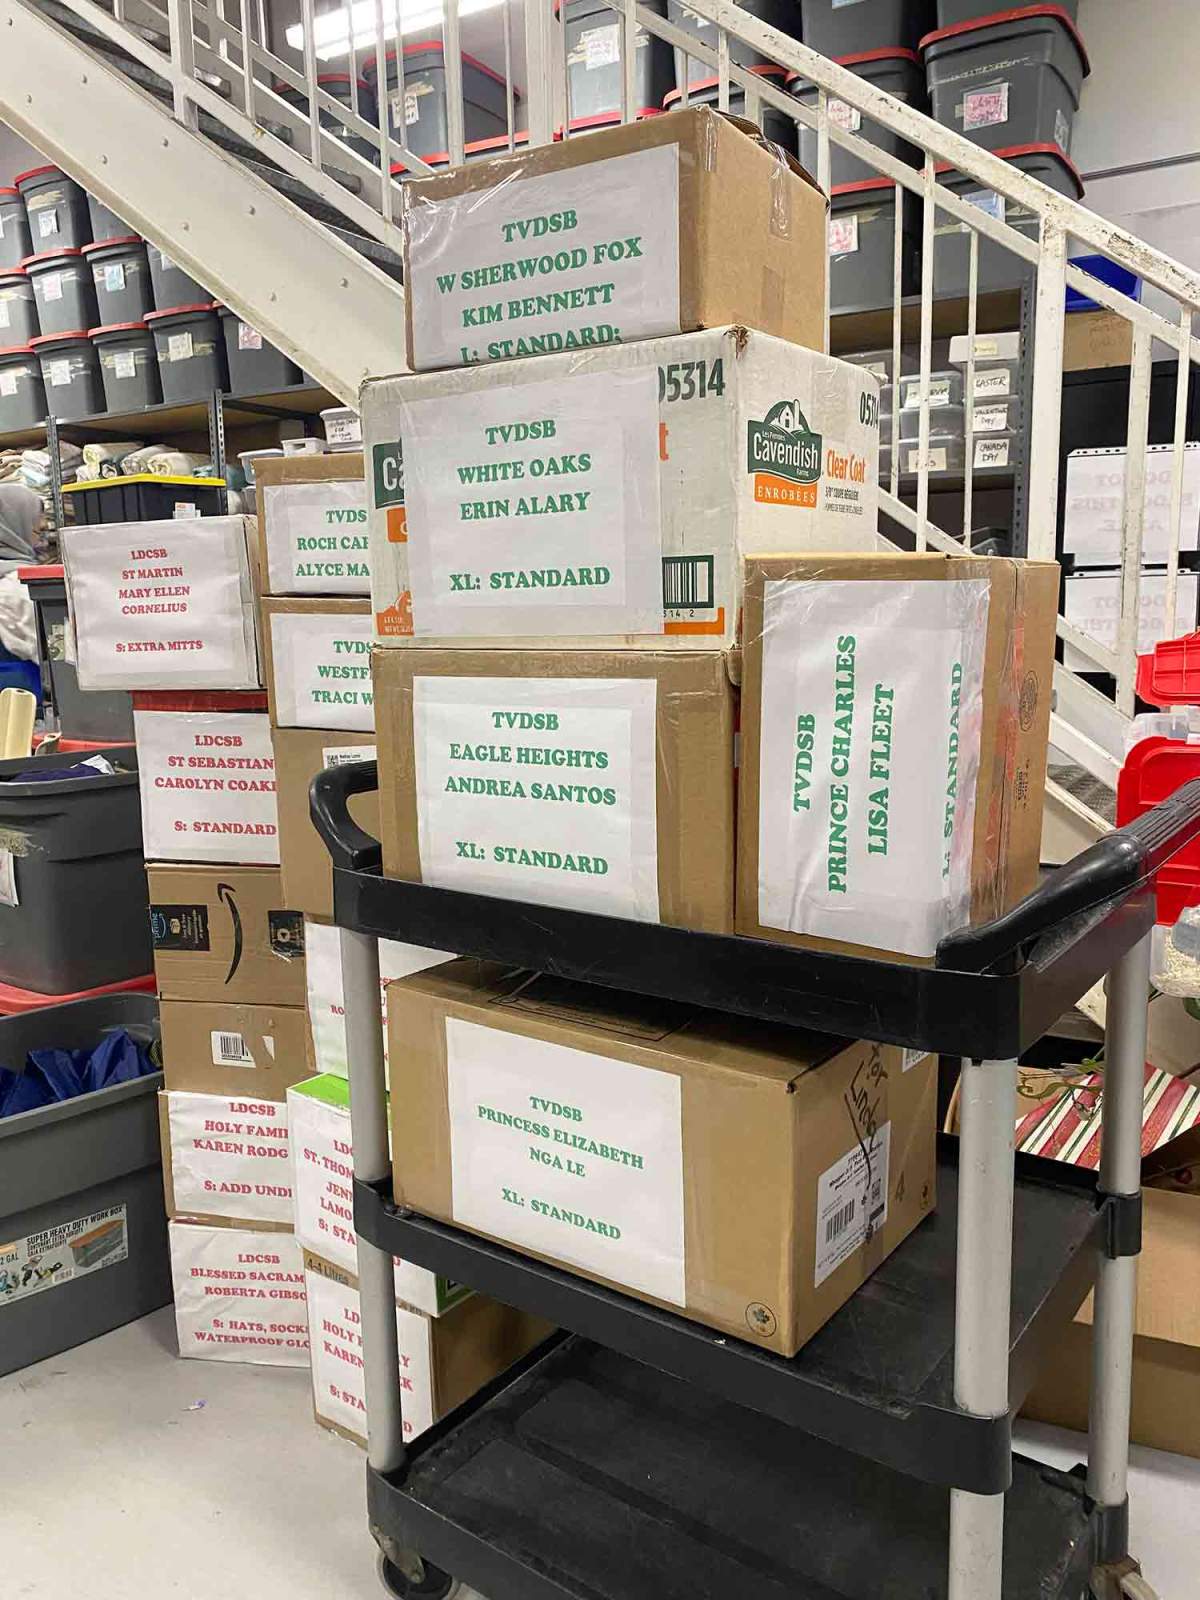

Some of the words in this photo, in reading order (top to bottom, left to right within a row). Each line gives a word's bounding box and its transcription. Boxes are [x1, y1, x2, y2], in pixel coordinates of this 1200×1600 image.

[502, 209, 577, 241] TVDSB
[437, 275, 455, 293] W
[461, 248, 587, 289] SHERWOOD
[594, 237, 642, 264] FOX
[462, 307, 502, 327] KIM
[508, 284, 614, 319] BENNETT
[460, 346, 481, 364] L:
[485, 420, 556, 444] TVDSB
[754, 432, 818, 469] Cavendish
[457, 462, 526, 485] WHITE
[530, 454, 592, 475] OAKS
[827, 449, 848, 480] Clear
[850, 454, 865, 483] Coat
[757, 486, 815, 502] ENROBÉES
[460, 500, 509, 520] ERIN
[515, 491, 589, 516] ALARY
[297, 537, 337, 550] ROCH
[131, 548, 168, 561] LDCSB
[122, 569, 136, 580] ST
[138, 567, 184, 579] MARTIN
[296, 563, 344, 577] ALYCE
[450, 573, 480, 591] XL:
[490, 567, 610, 590] STANDARD
[119, 588, 153, 600] MARY
[154, 586, 191, 598] ELLEN
[122, 602, 188, 615] CORNELIUS
[116, 642, 126, 653] S:
[128, 641, 165, 653] EXTRA
[166, 640, 203, 651] MITTS
[312, 690, 359, 705] TRACI
[830, 634, 857, 778] CHARLES
[492, 711, 560, 731] TVDSB
[869, 682, 896, 781] FLEET
[194, 735, 243, 747] LDCSB
[449, 743, 513, 764] EAGLE
[516, 746, 609, 770] HEIGHTS
[944, 661, 963, 840] STANDARD
[168, 756, 185, 767] ST
[188, 757, 275, 770] SEBASTIAN
[792, 712, 817, 814] TVDSB
[155, 777, 224, 790] CAROLYN
[444, 775, 527, 799] ANDREA
[530, 782, 617, 806] SANTOS
[174, 821, 187, 832] S:
[193, 822, 277, 836] STANDARD
[866, 785, 890, 857] LISA
[827, 783, 849, 895] PRINCE
[455, 841, 486, 861] XL:
[493, 845, 609, 876] STANDARD
[229, 1102, 276, 1117] LDCSB
[528, 1095, 584, 1123] TVDSB
[204, 1119, 243, 1134] HOLY
[193, 1138, 244, 1155] KAREN
[477, 1105, 550, 1141] PRINCESS
[552, 1128, 645, 1171] ELIZABETH
[303, 1148, 321, 1166] ST.
[333, 1139, 353, 1157] LD
[528, 1146, 564, 1173] NGA
[565, 1156, 587, 1178] LE
[203, 1180, 217, 1192] S:
[220, 1182, 252, 1195] ADD
[500, 1187, 526, 1210] XL:
[530, 1198, 622, 1241] STANDARD
[26, 1231, 49, 1245] SUPER
[49, 1222, 72, 1238] HEAVY
[72, 1216, 90, 1230] DUTY
[90, 1209, 110, 1223] WORK
[109, 1206, 123, 1217] BOX
[318, 1218, 330, 1232] S:
[6, 1252, 19, 1264] GAL
[238, 1254, 281, 1265] LDCSB
[190, 1267, 247, 1280] BLESSED
[249, 1272, 305, 1284] SACRAM
[204, 1286, 266, 1299] ROBERTA
[212, 1319, 225, 1329] S:
[229, 1320, 268, 1334] HATS,
[269, 1323, 309, 1335] SOCK
[322, 1319, 354, 1343] HOLY
[194, 1331, 285, 1346] WATERPROOF
[323, 1340, 365, 1369] KAREN
[329, 1384, 341, 1400] S:
